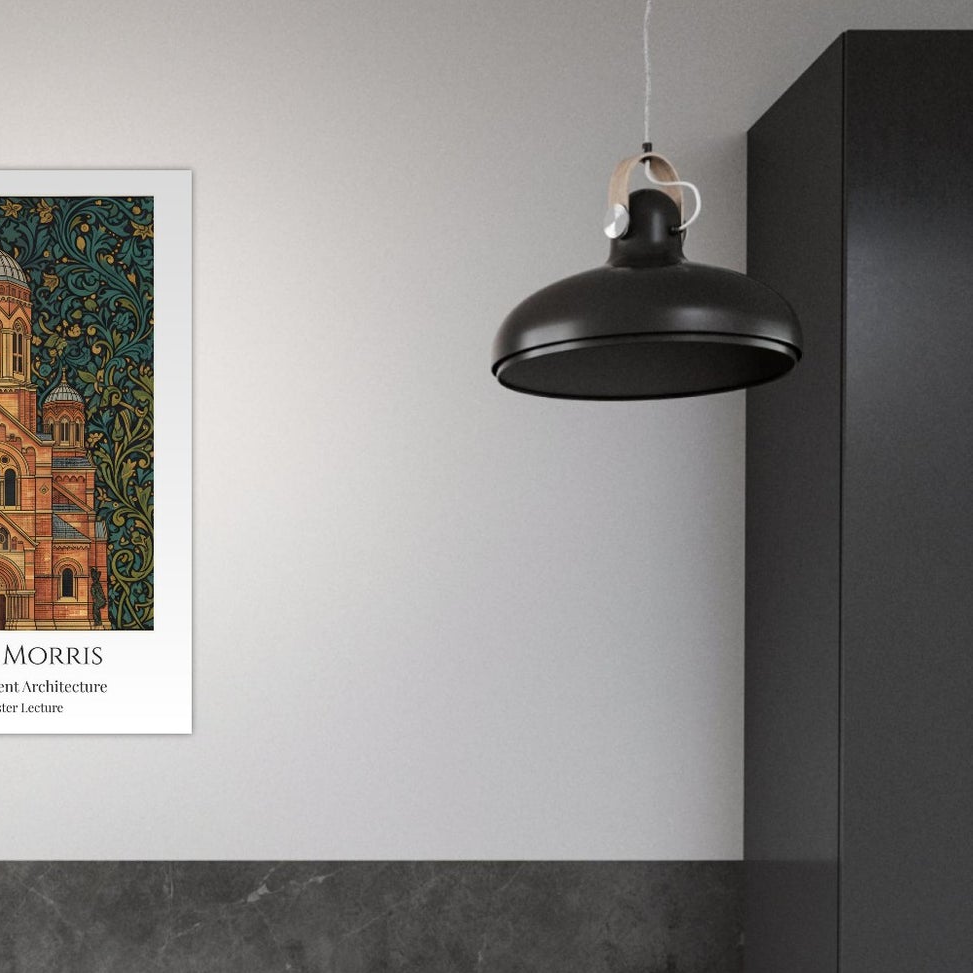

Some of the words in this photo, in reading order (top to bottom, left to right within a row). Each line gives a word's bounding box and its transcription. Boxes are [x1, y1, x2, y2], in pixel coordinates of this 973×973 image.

[3, 644, 103, 665] MORRIS
[22, 680, 107, 693] Architecture
[21, 702, 63, 713] Lecture
